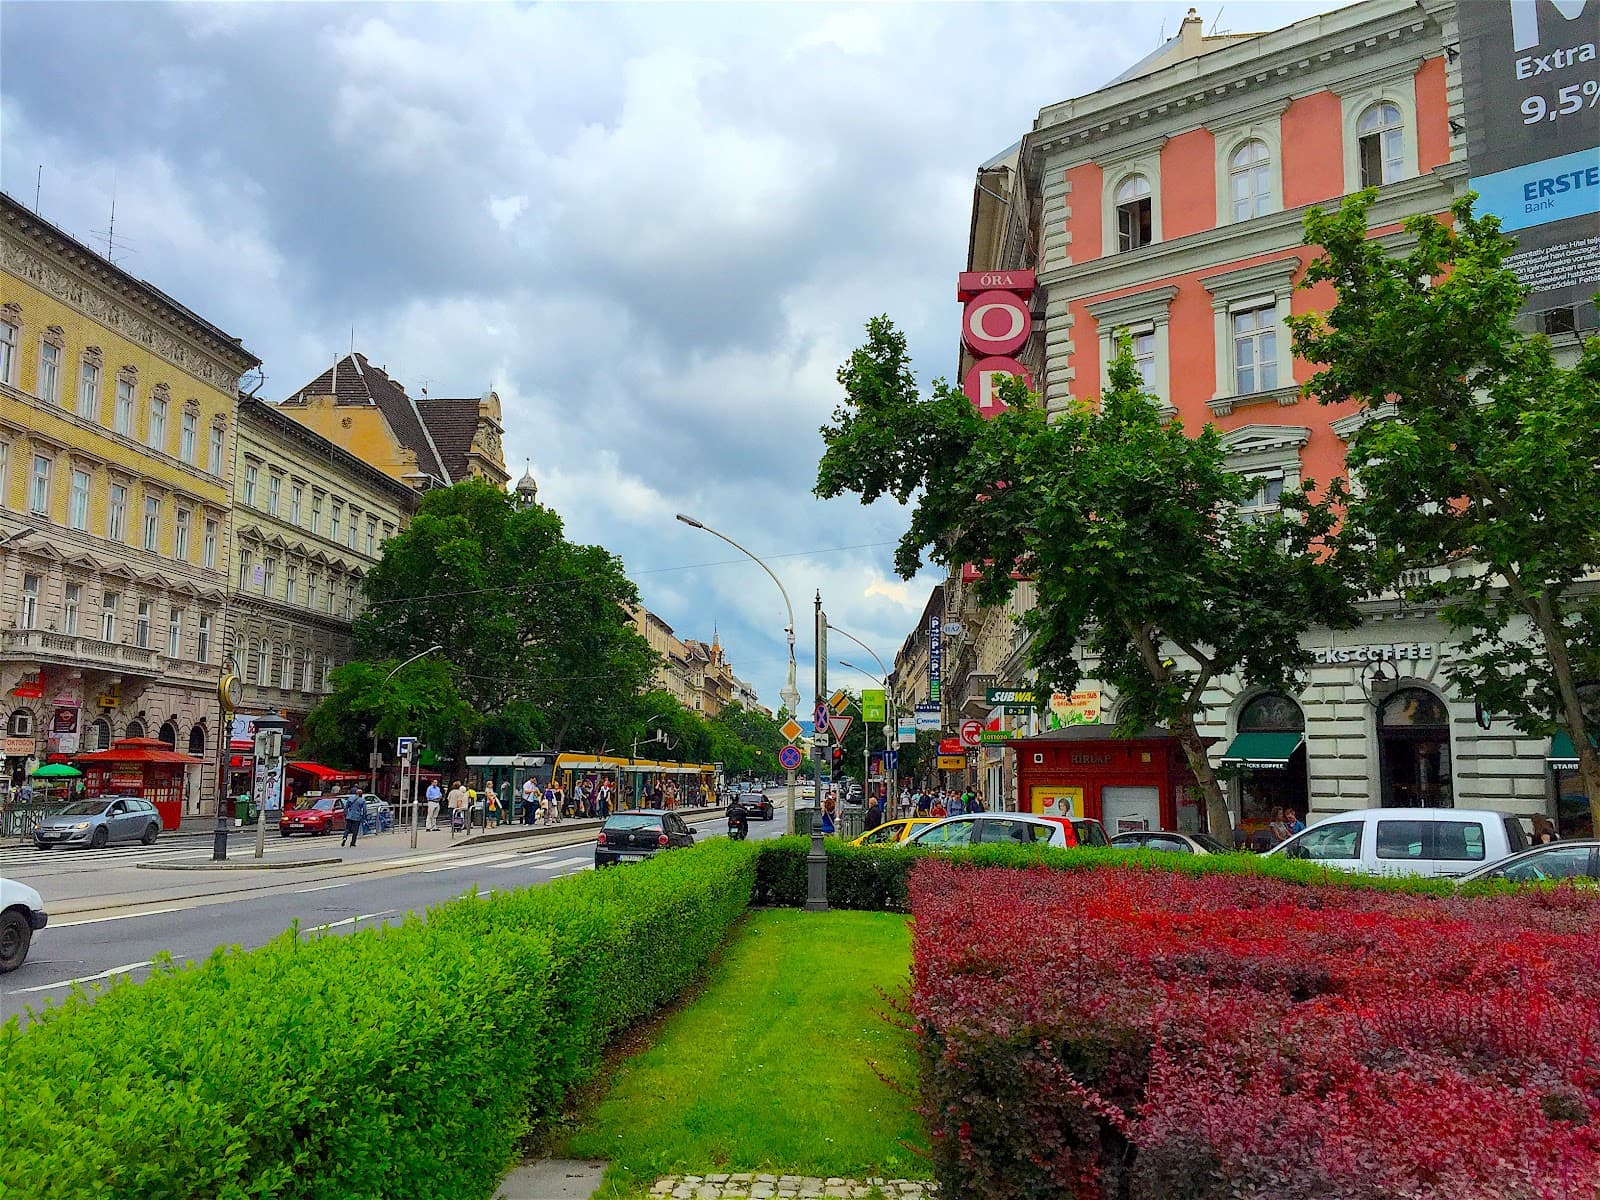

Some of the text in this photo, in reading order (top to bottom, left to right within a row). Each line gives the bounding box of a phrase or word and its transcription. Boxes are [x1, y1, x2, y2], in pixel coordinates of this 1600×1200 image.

[1515, 43, 1597, 80] Extra
[1523, 166, 1599, 202] ERSTE
[1524, 198, 1555, 214] Bank
[980, 272, 1013, 287] ÓRA
[1355, 644, 1432, 662] COFFEE
